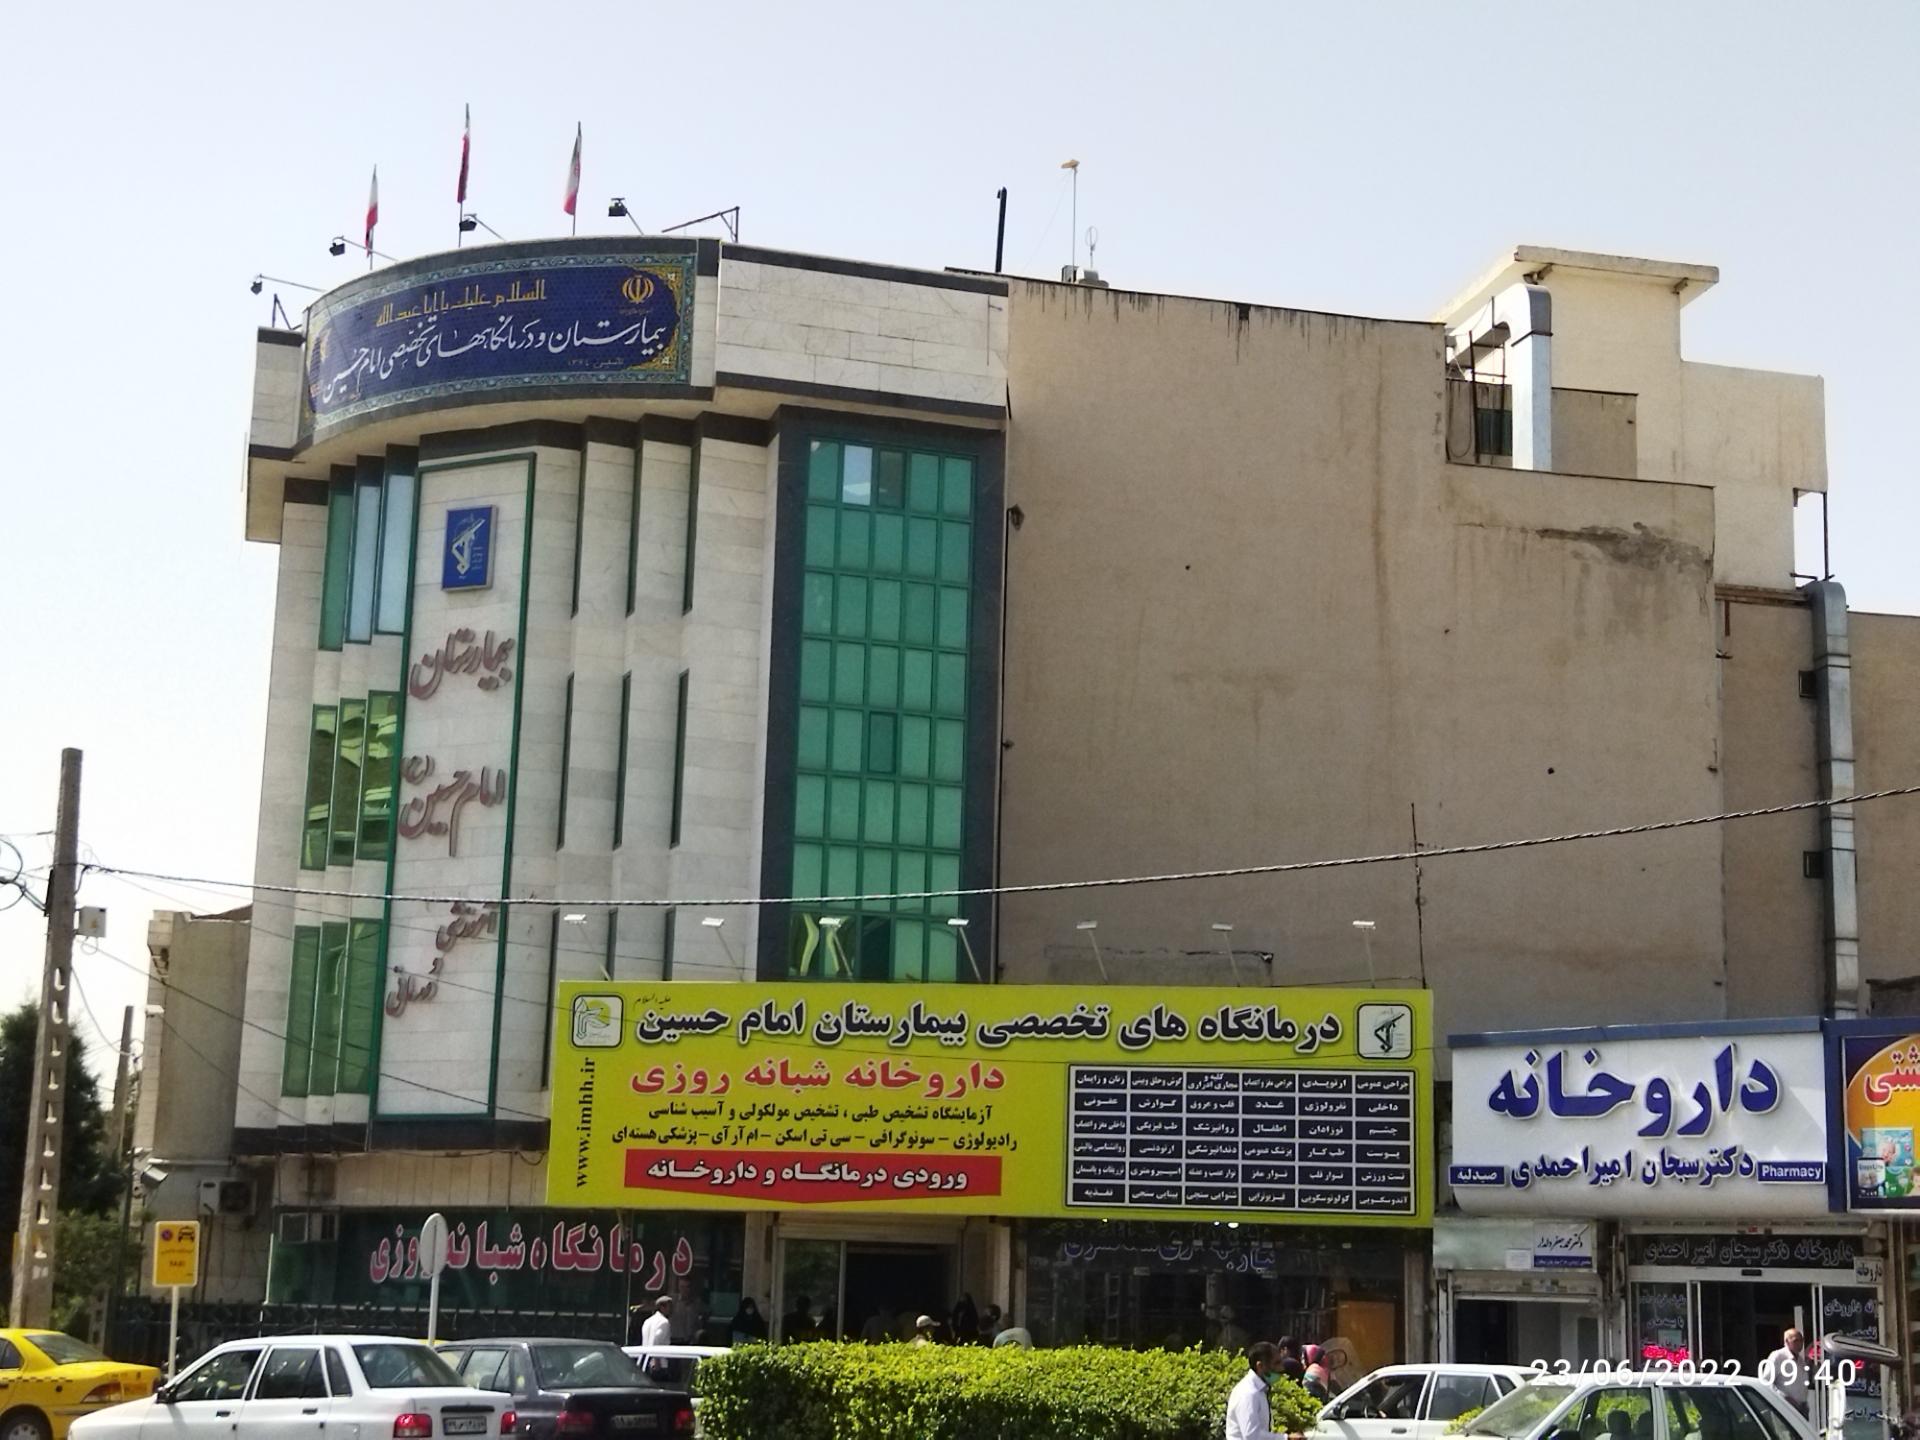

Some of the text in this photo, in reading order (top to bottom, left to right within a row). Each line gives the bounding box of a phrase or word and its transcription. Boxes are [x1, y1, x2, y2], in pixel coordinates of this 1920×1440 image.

[548, 317, 667, 355] بیمارستان
[323, 347, 370, 404] حسین
[357, 347, 382, 393] امام
[409, 627, 515, 700] بیمارستان
[399, 766, 506, 858] امام حسین
[638, 1001, 1340, 1051] درمانگاه های تخصصی بیمارستان امام حسین
[631, 1058, 1006, 1098] داروخانه شبانه روزی
[1487, 1042, 1781, 1138] داروخانه
[649, 1101, 687, 1119] شناسی
[691, 1101, 724, 1119] آسیب
[739, 1103, 790, 1121] مولکولی
[794, 1104, 839, 1122] تشخیص
[851, 1105, 879, 1122] طبی
[1255, 1099, 1285, 1109] غدد
[1368, 1102, 1399, 1113] داخلی
[576, 1057, 595, 1188] www.imhh.ir
[882, 1106, 928, 1123] تشخیص
[932, 1105, 993, 1124] آزمایشگاه
[658, 1127, 698, 1145] پزشکی
[775, 1129, 807, 1146] اسکن
[810, 1129, 827, 1146] تی
[1252, 1124, 1287, 1134] اطفال
[1308, 1125, 1344, 1136] نوزادان
[830, 1134, 851, 1147] سی
[869, 1130, 935, 1149] سونوگرافی
[953, 1132, 1017, 1151] رادیولوژی
[1366, 1150, 1400, 1160] پوست
[647, 1160, 968, 1189] ورودی درمانگاه و داروخانه
[1510, 1145, 1756, 1189] دکتر سبحان امیر احمدی
[1761, 1163, 1822, 1180] Pharmacy
[370, 1223, 433, 1284] وزی
[529, 1220, 693, 1291] درمانگاه
[1794, 1239, 1854, 1266] داروخانه
